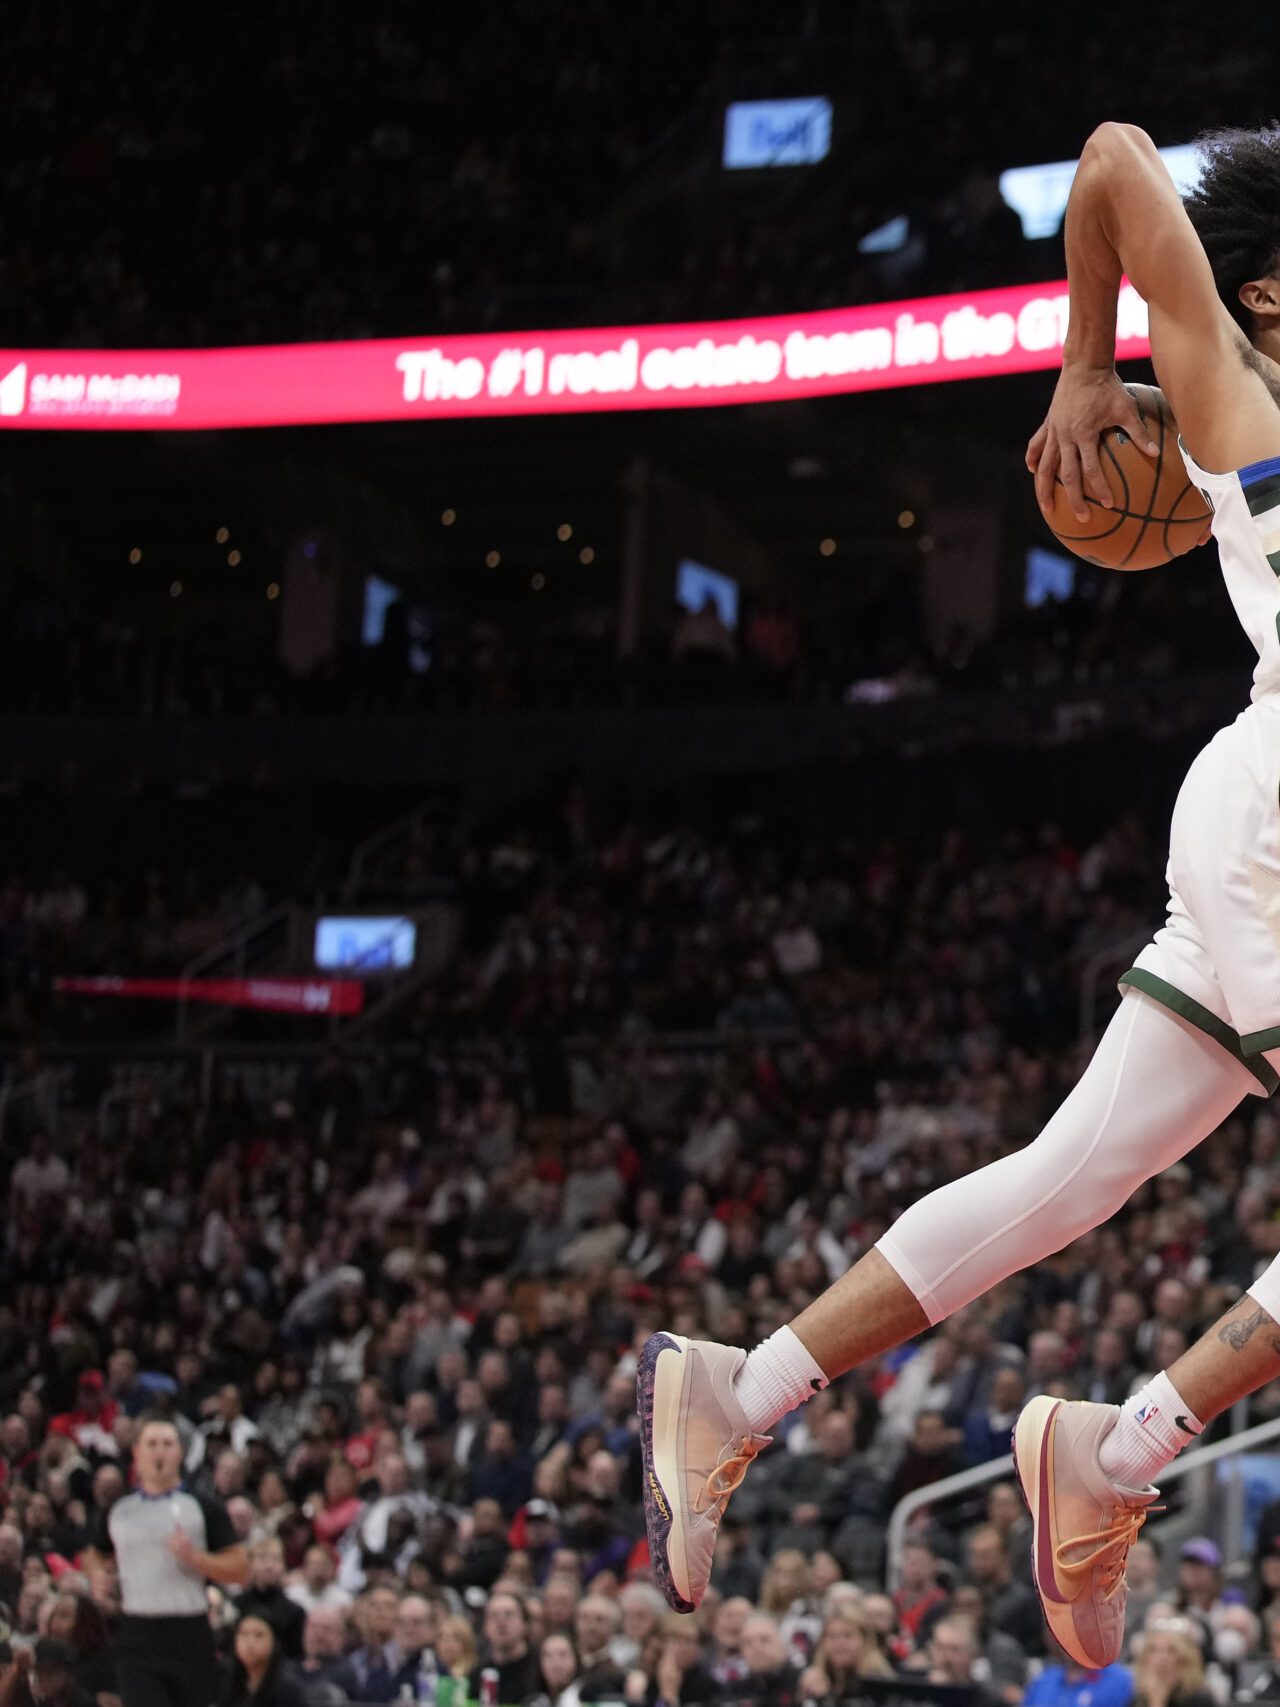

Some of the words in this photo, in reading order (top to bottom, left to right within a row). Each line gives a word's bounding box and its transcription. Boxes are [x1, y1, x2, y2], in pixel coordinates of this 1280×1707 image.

[395, 347, 484, 402] The
[487, 347, 544, 397] #1
[547, 338, 639, 395] real
[640, 335, 782, 391] estate
[783, 330, 893, 380] team
[894, 312, 939, 367] in
[940, 304, 1015, 361] the
